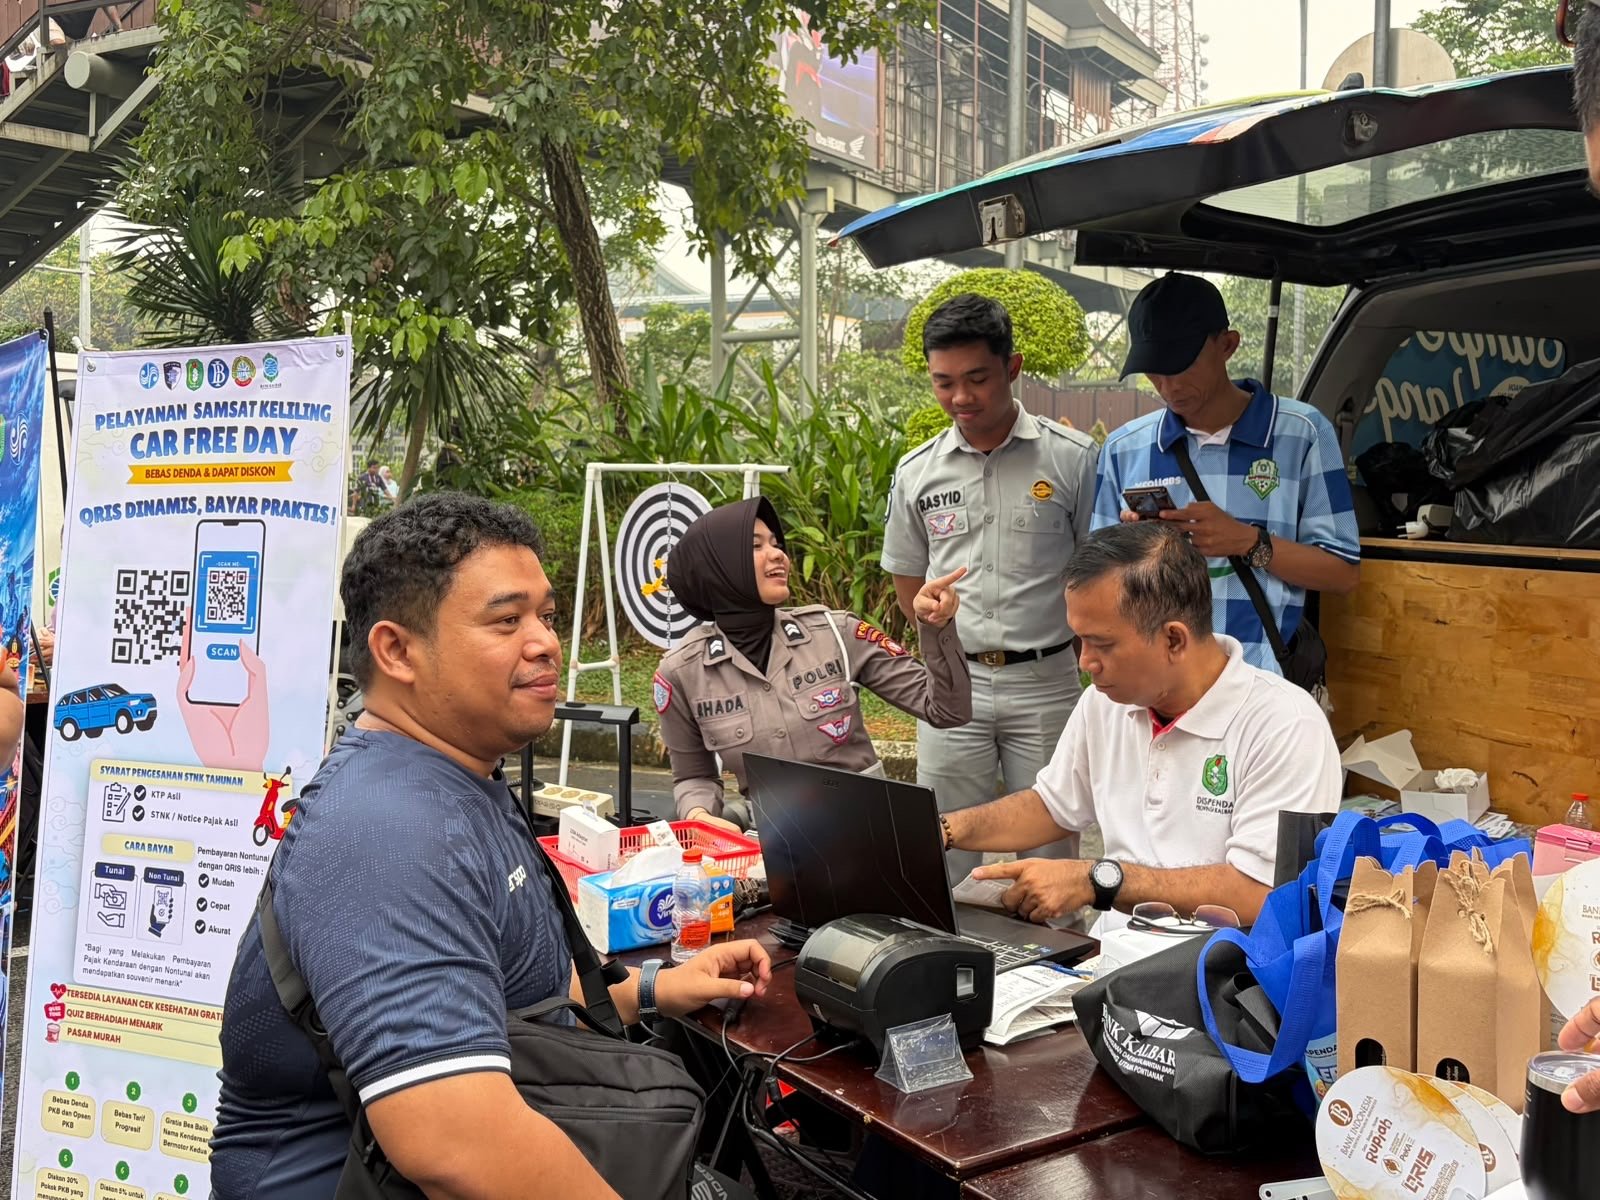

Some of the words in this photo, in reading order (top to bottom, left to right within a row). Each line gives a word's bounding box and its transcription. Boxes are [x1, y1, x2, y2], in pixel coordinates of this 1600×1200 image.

[95, 404, 188, 431] PELAYANAN
[193, 400, 258, 420] SAMSAT
[259, 401, 332, 423] KELILING
[130, 428, 180, 460] CAR
[183, 425, 239, 456] FREE
[243, 426, 299, 456] DAY
[145, 468, 171, 479] BEBAS
[173, 467, 202, 479] DENDA
[204, 468, 210, 478] &
[212, 467, 240, 478] DAPAT
[241, 466, 276, 477] DISKON
[920, 490, 961, 513] RASYID
[80, 502, 123, 527] QRIS
[125, 496, 203, 520] DINAMIS,
[205, 495, 259, 514] BAYAR
[212, 647, 237, 657] SCAN
[793, 659, 844, 689] POLRI
[100, 766, 131, 777] SYARAT
[131, 768, 184, 782] PENGESAHAN
[184, 771, 205, 783] STNK
[206, 774, 243, 787] TAHUNAN
[151, 791, 166, 800] KTP
[1197, 796, 1234, 809] DISPENDA
[151, 810, 170, 821] STNK
[177, 813, 202, 824] Notice
[203, 815, 222, 827] Pajak
[124, 840, 147, 853] CARA
[147, 842, 174, 855] BAYAR
[198, 847, 237, 861] Pembayaran
[238, 852, 270, 864] Nontunai
[105, 866, 126, 876] Tunai
[198, 861, 222, 873] dengan
[224, 863, 241, 875] QRIS
[242, 865, 259, 876] lebih
[148, 871, 161, 881] Non
[161, 873, 181, 883] Tunai
[212, 877, 235, 888] Mudah
[210, 901, 230, 913] Cepat
[1582, 903, 1600, 915] BAN
[209, 925, 231, 936] Akurat
[109, 946, 125, 957] yang
[132, 949, 166, 962] Melakukan
[172, 955, 212, 969] Pembayaran
[82, 966, 125, 981] mendapatkan
[126, 972, 154, 985] souvenir
[83, 955, 101, 966] Pajak
[103, 957, 137, 970] Kendaraan
[138, 962, 163, 974] dengan
[165, 966, 193, 978] Nontunai
[194, 972, 210, 982] akan
[66, 989, 101, 1002] TERSEDIA
[102, 994, 138, 1007] LAYANAN
[138, 999, 154, 1010] CEK
[154, 1001, 199, 1018] KESEHATAN
[200, 1009, 224, 1022] GRATI
[66, 1008, 85, 1019] QUIZ
[85, 1011, 128, 1026] BERHADIAH
[129, 1017, 163, 1032] MENARIK
[67, 1027, 91, 1039] PASAR
[92, 1031, 121, 1043] MURAH
[1121, 1032, 1177, 1068] KALBAR
[52, 1096, 71, 1107] Bebas
[48, 1106, 61, 1115] PKB
[61, 1109, 72, 1118] dan
[114, 1109, 132, 1120] Bebas
[62, 1120, 74, 1130] PKB
[1340, 1133, 1356, 1156] BANK
[1350, 1095, 1374, 1135] INDONESIA
[163, 1140, 189, 1153] Bermotor
[1365, 1117, 1393, 1164] Rupiah
[1403, 1146, 1435, 1194] QRIS
